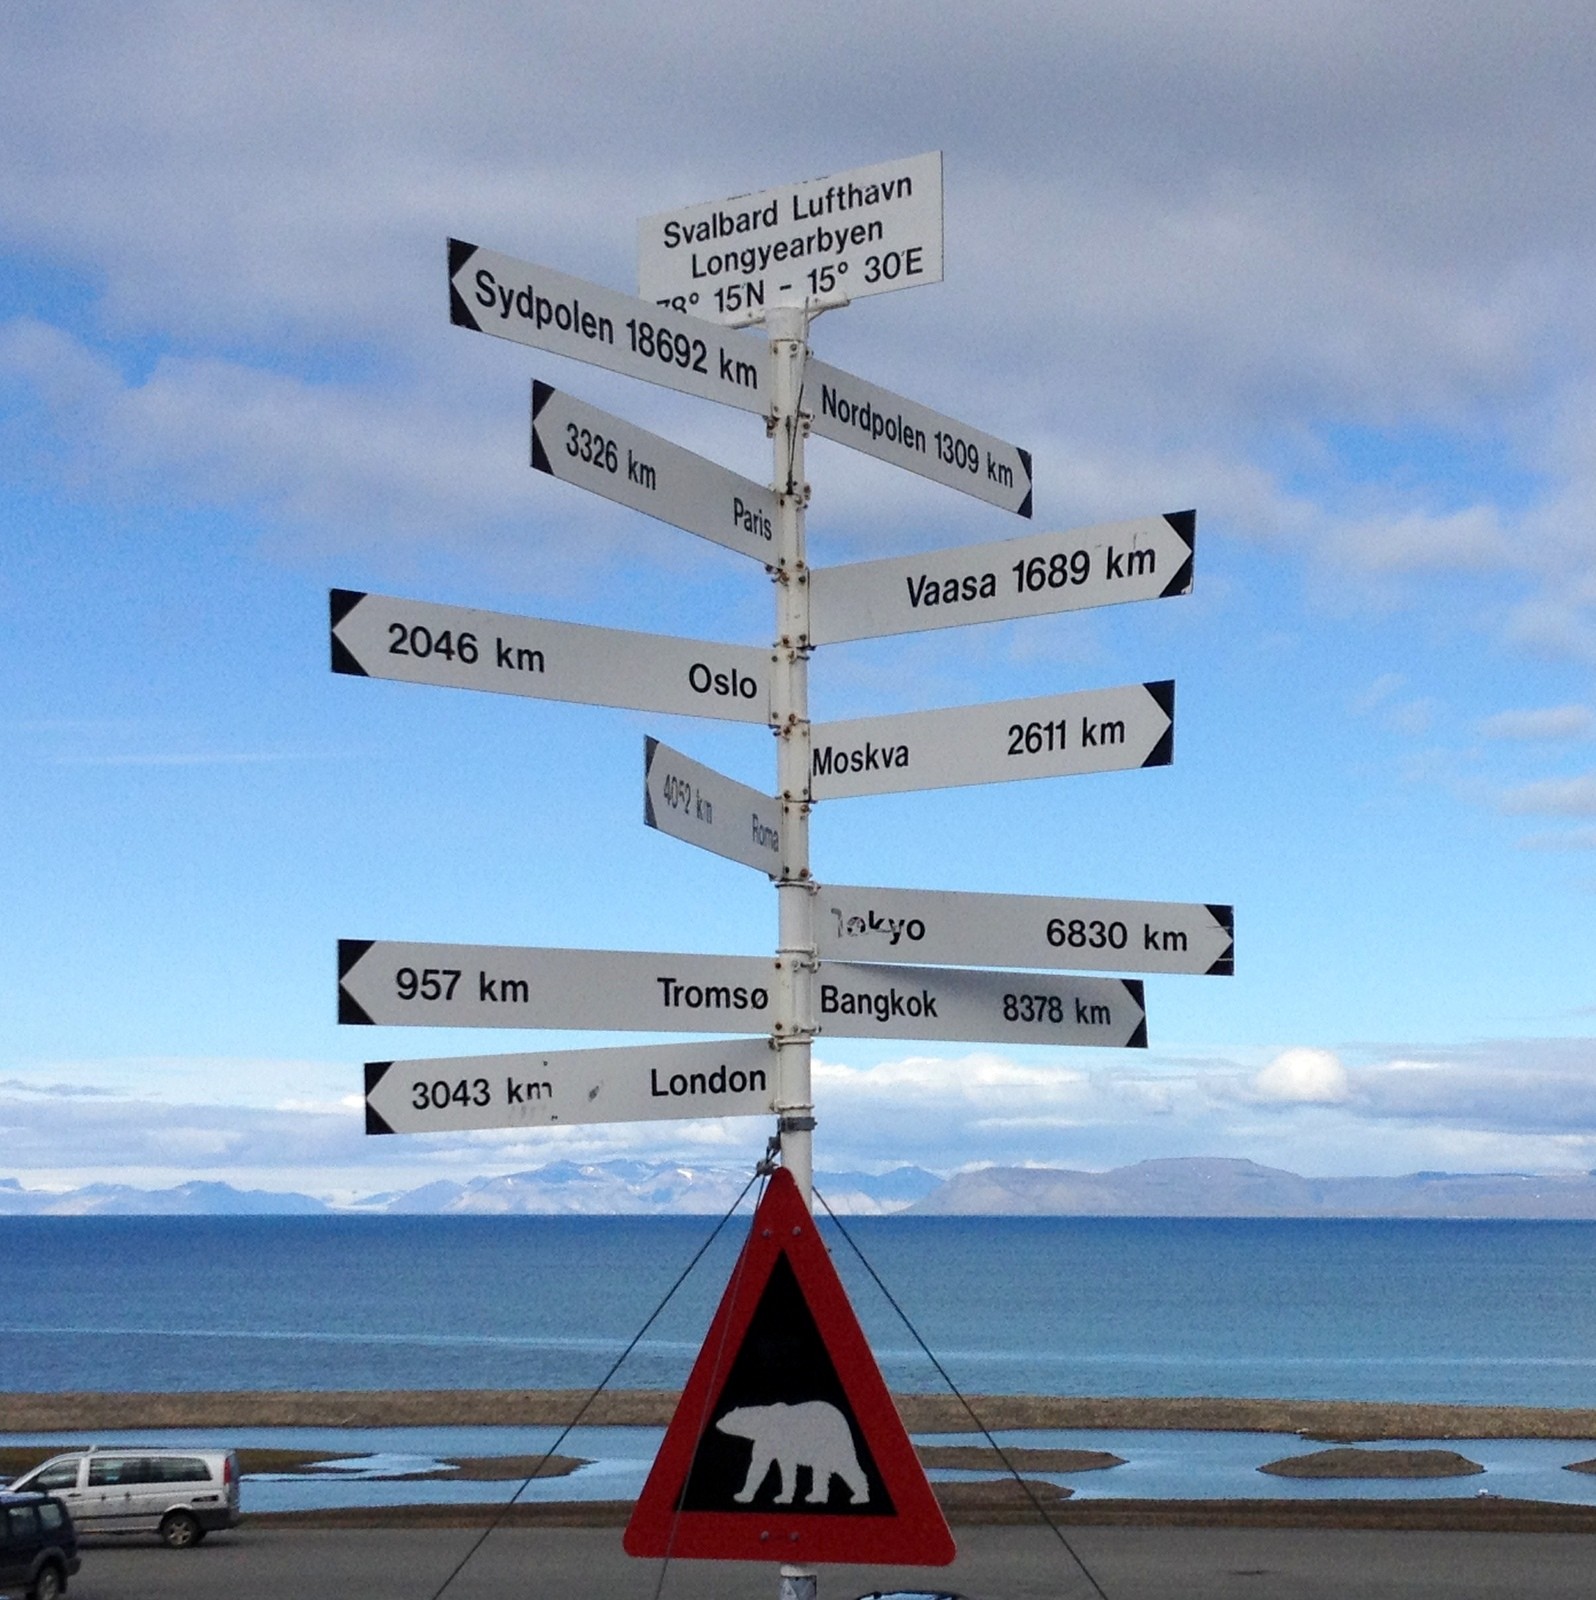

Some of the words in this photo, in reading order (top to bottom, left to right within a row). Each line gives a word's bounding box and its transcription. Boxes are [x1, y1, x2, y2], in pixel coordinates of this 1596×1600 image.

[663, 200, 779, 249] Svalbard
[793, 177, 912, 221] Lufthavn
[691, 218, 883, 279] Longyearbyen
[807, 262, 848, 294] 15°
[474, 269, 614, 345] Sydpolen
[626, 312, 707, 374] 18692
[720, 347, 757, 389] km
[822, 384, 925, 453] Nordpolen
[934, 431, 979, 473] 1309
[987, 452, 1013, 488] km
[566, 423, 617, 473] 3326
[628, 450, 656, 490] km
[734, 497, 772, 541] Paris
[907, 573, 996, 607] Vaasa
[1012, 550, 1090, 593] 1689
[1106, 546, 1155, 580] km
[389, 623, 478, 664] 2046
[497, 638, 544, 673] km
[689, 663, 757, 698] Oslo
[813, 742, 908, 776] Moskva
[1008, 720, 1065, 755] 2611
[1082, 717, 1124, 747] km
[696, 789, 712, 824] km
[752, 813, 779, 852] Roma
[1047, 919, 1127, 949] 6830
[1145, 924, 1187, 951] km
[396, 968, 461, 1000] 957
[480, 971, 528, 1003] km
[657, 977, 768, 1009] Tromsø
[821, 985, 937, 1022] Bangkok
[1003, 994, 1063, 1023] 8378
[1075, 997, 1110, 1025] km
[412, 1079, 490, 1110] 3043
[508, 1077, 552, 1104] km
[651, 1065, 766, 1096] London
